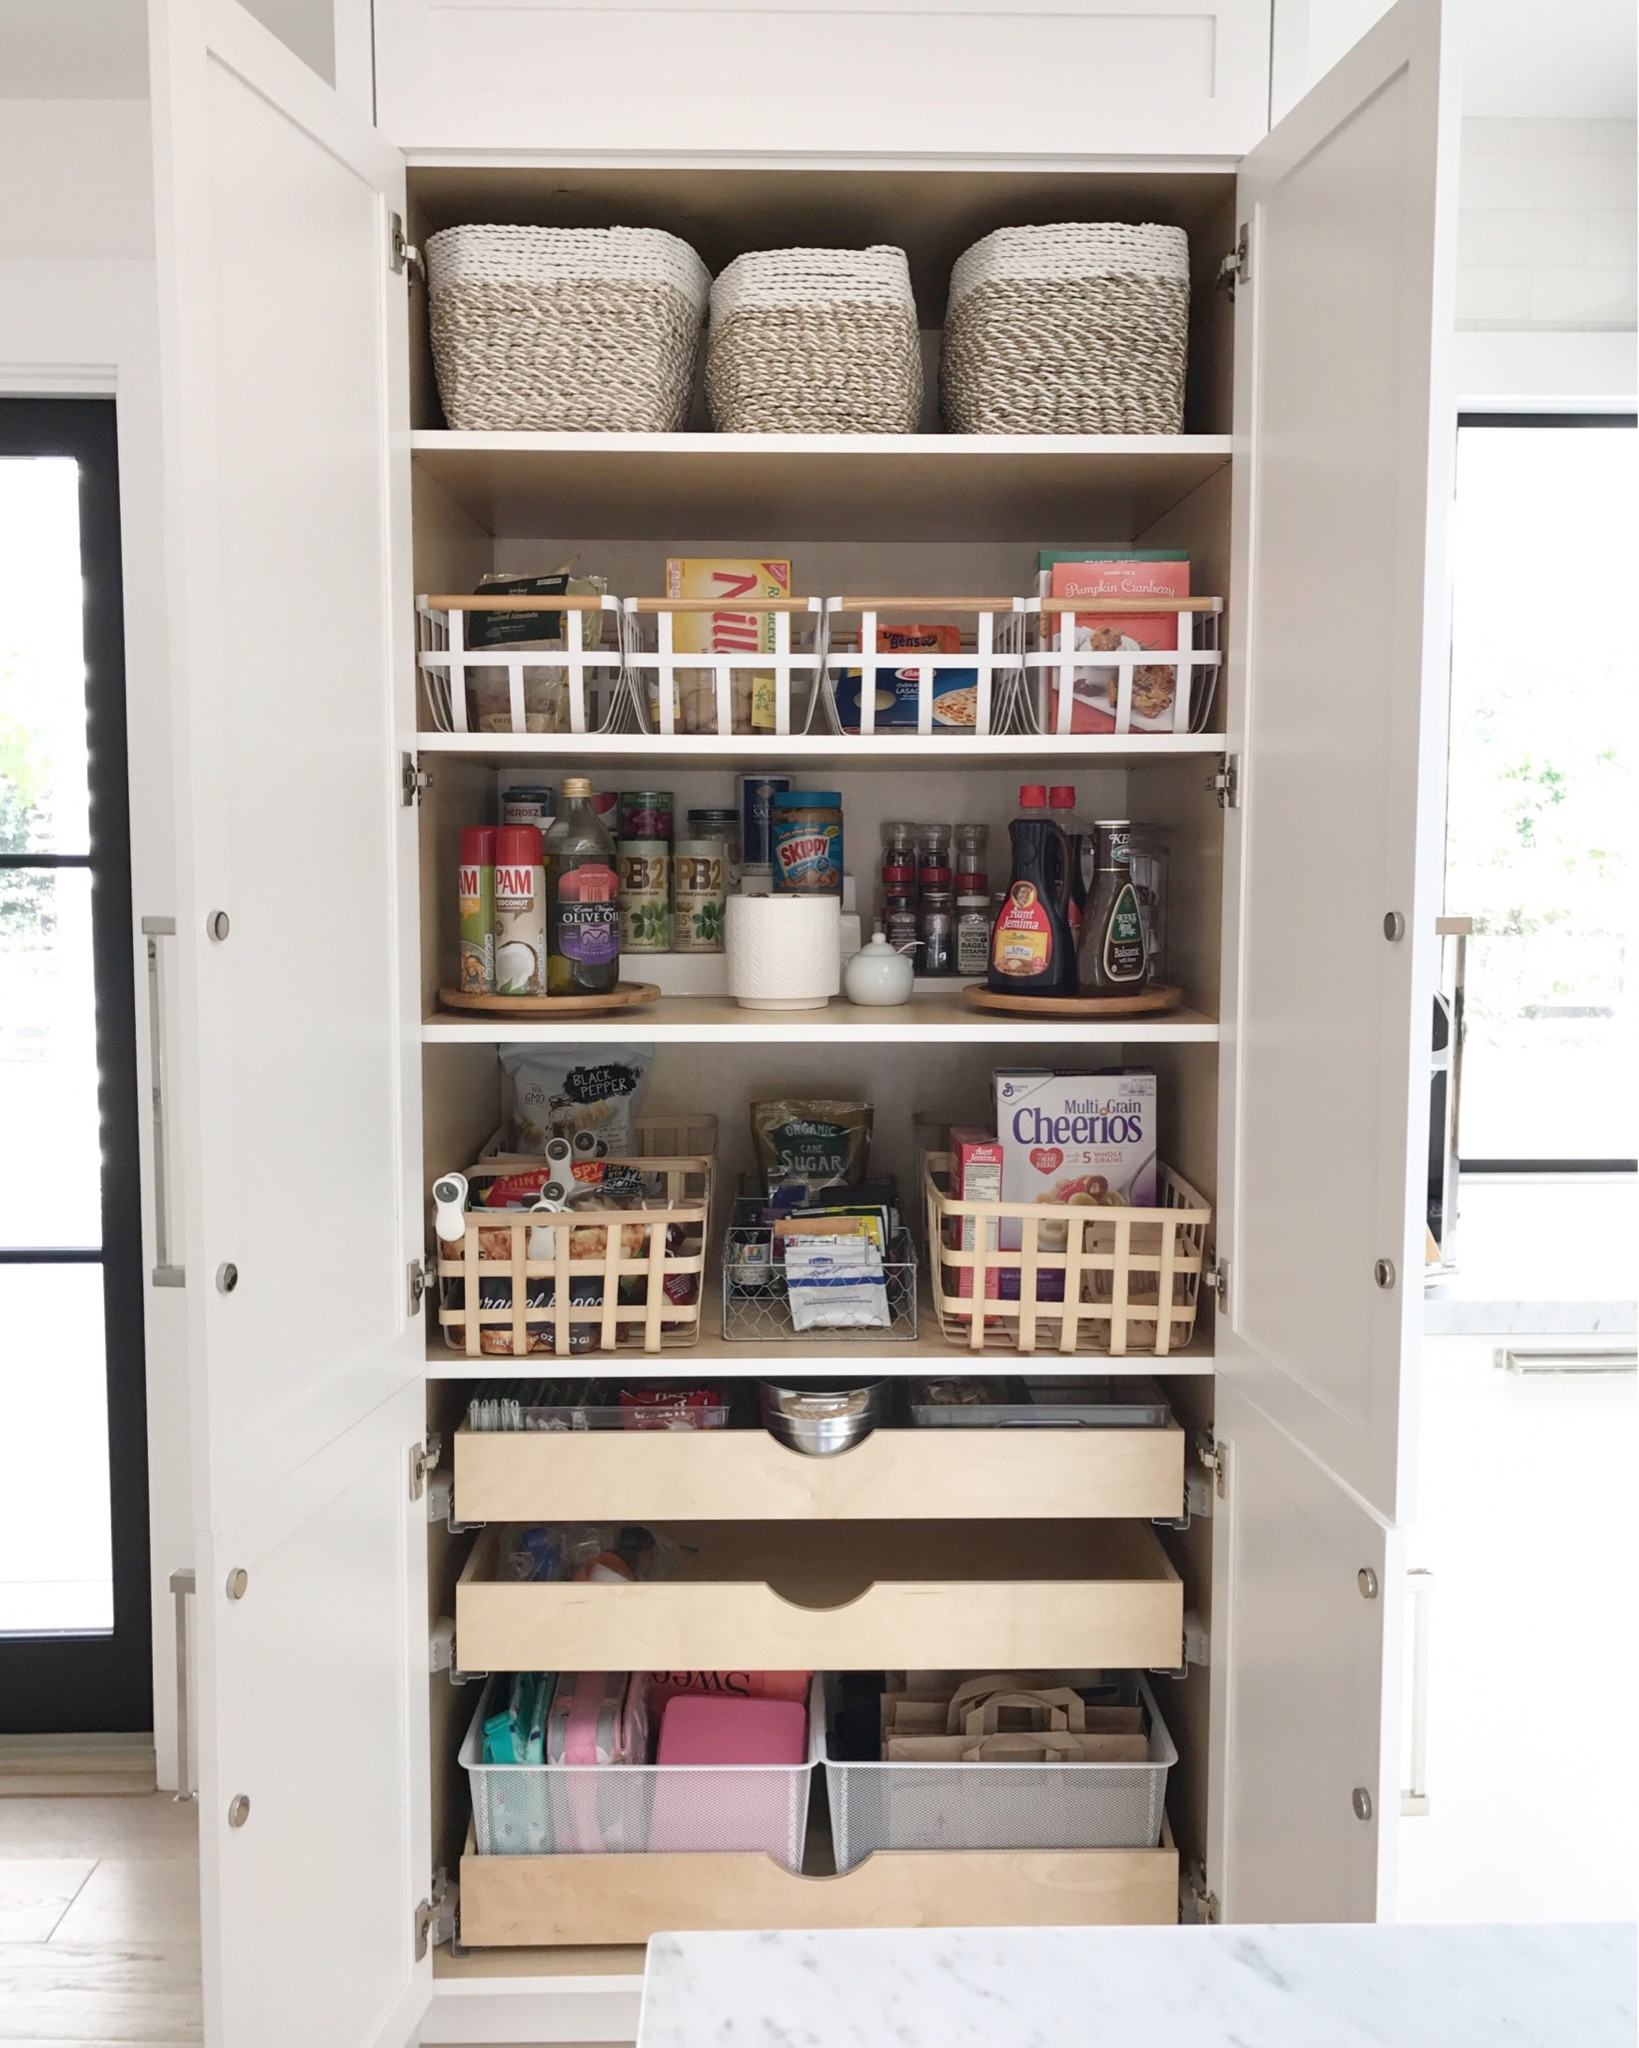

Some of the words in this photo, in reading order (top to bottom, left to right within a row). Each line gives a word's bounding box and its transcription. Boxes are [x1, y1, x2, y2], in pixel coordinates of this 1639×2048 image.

[1065, 582, 1118, 597] Pumpkin
[1121, 578, 1175, 597] Cranberry
[712, 571, 758, 654] Nill
[505, 807, 541, 818] HERDEZ
[780, 838, 828, 867] SKIPPY
[675, 857, 721, 890] PB2
[459, 869, 478, 895] AM
[495, 869, 533, 895] PAM
[497, 899, 529, 907] COCONUT
[562, 912, 600, 923] OLIVE
[1010, 906, 1035, 919] Aunt
[1000, 916, 1040, 930] Jemima
[572, 1069, 612, 1087] BLACK
[580, 1077, 629, 1099] PEPPER
[525, 1092, 546, 1105] GMO
[1064, 1099, 1099, 1115] Multi
[1106, 1099, 1142, 1114] Grain
[784, 1123, 838, 1137] ORGANIC
[1012, 1107, 1143, 1145] Cheerios
[800, 1144, 824, 1154] CANE
[781, 1149, 845, 1172] SUGAR
[1082, 1151, 1092, 1164] 5
[573, 1162, 601, 1180] SPY
[492, 1338, 509, 1346] NET
[540, 1332, 554, 1342] OZ
